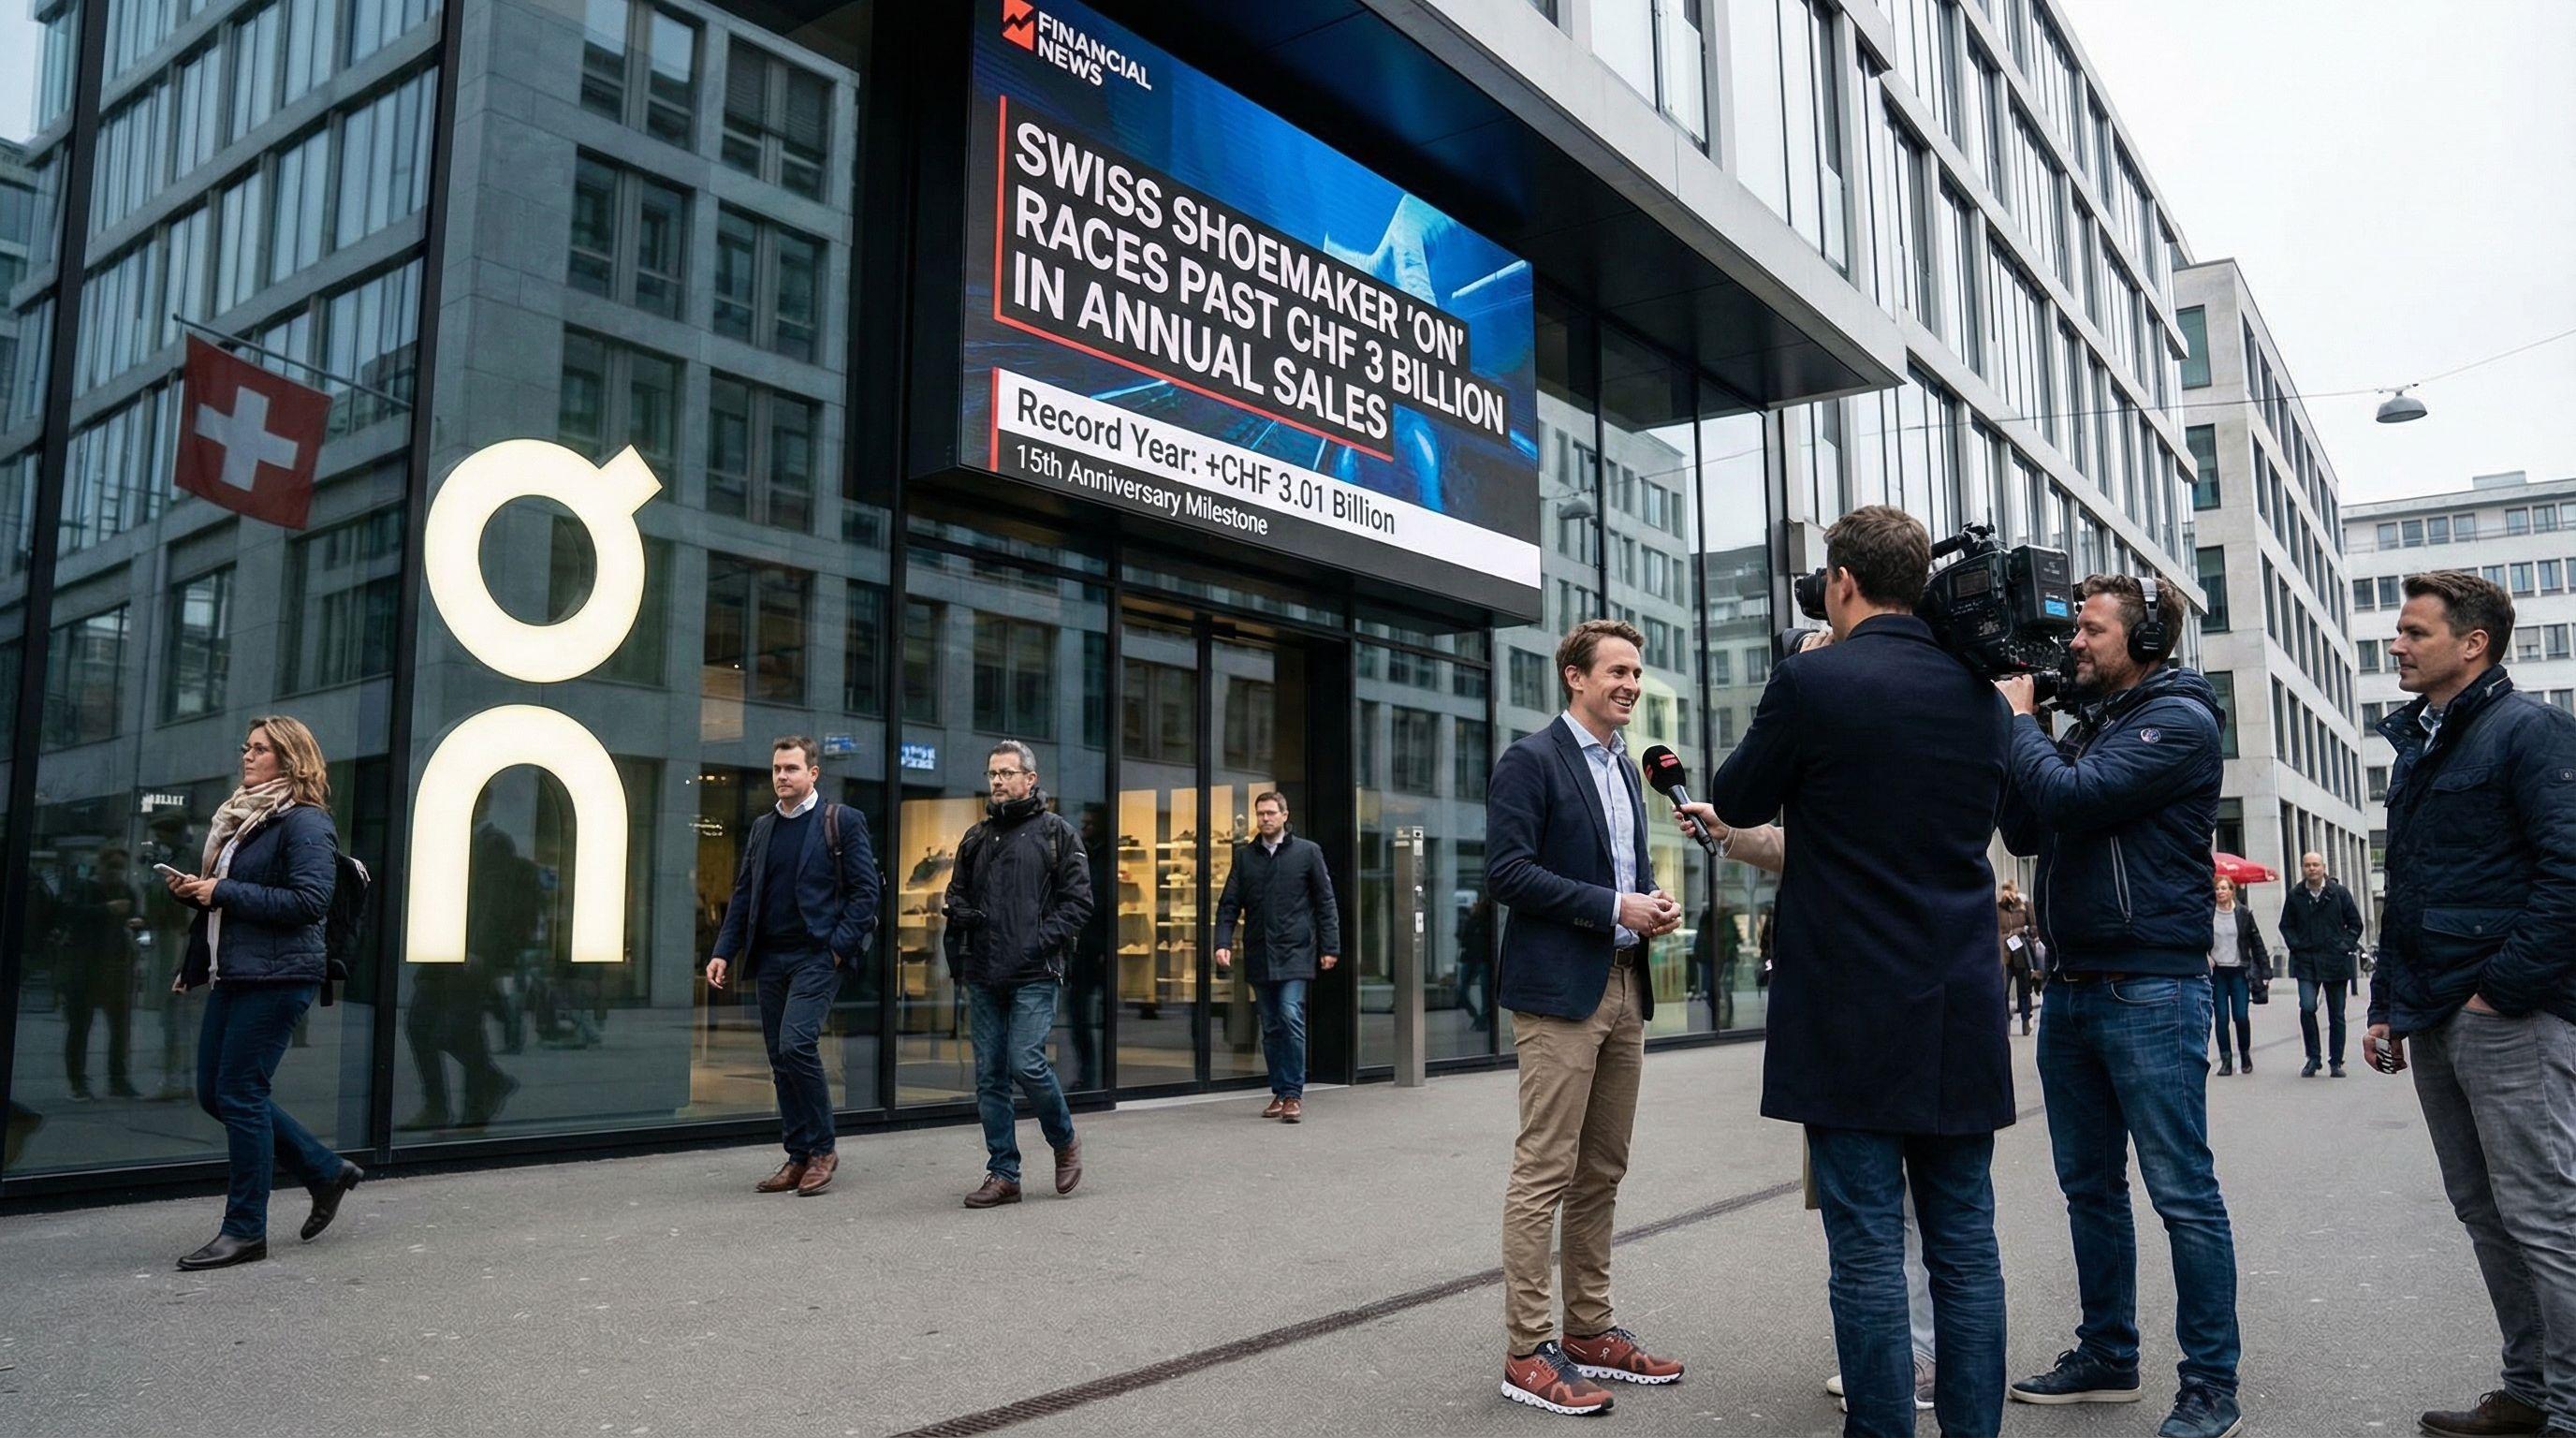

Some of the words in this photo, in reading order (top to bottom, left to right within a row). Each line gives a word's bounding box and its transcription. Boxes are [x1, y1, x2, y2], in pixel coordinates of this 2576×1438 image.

[1038, 10, 1152, 91] FINANCIAL
[1038, 35, 1103, 86] NEWS
[1016, 122, 1163, 228] SWISS
[1172, 196, 1399, 339] SHOEMAKER
[1014, 251, 1064, 321] IN
[1076, 281, 1265, 396] ANNUAL
[1273, 356, 1388, 440] SALES
[1017, 184, 1169, 294] RACES
[1179, 256, 1280, 340] PAST
[1287, 306, 1357, 370] CHF
[1365, 340, 1384, 384] 3
[1391, 349, 1504, 435] BILLION
[1017, 387, 1122, 451] Record
[1130, 422, 1197, 475] Year:
[1205, 453, 1272, 495] +CHF
[1279, 472, 1324, 514] 3.01
[1333, 489, 1396, 536] Billion
[1017, 444, 1063, 480] 15th
[1067, 459, 1181, 517] Anniversary
[1185, 492, 1268, 536] Milestone
